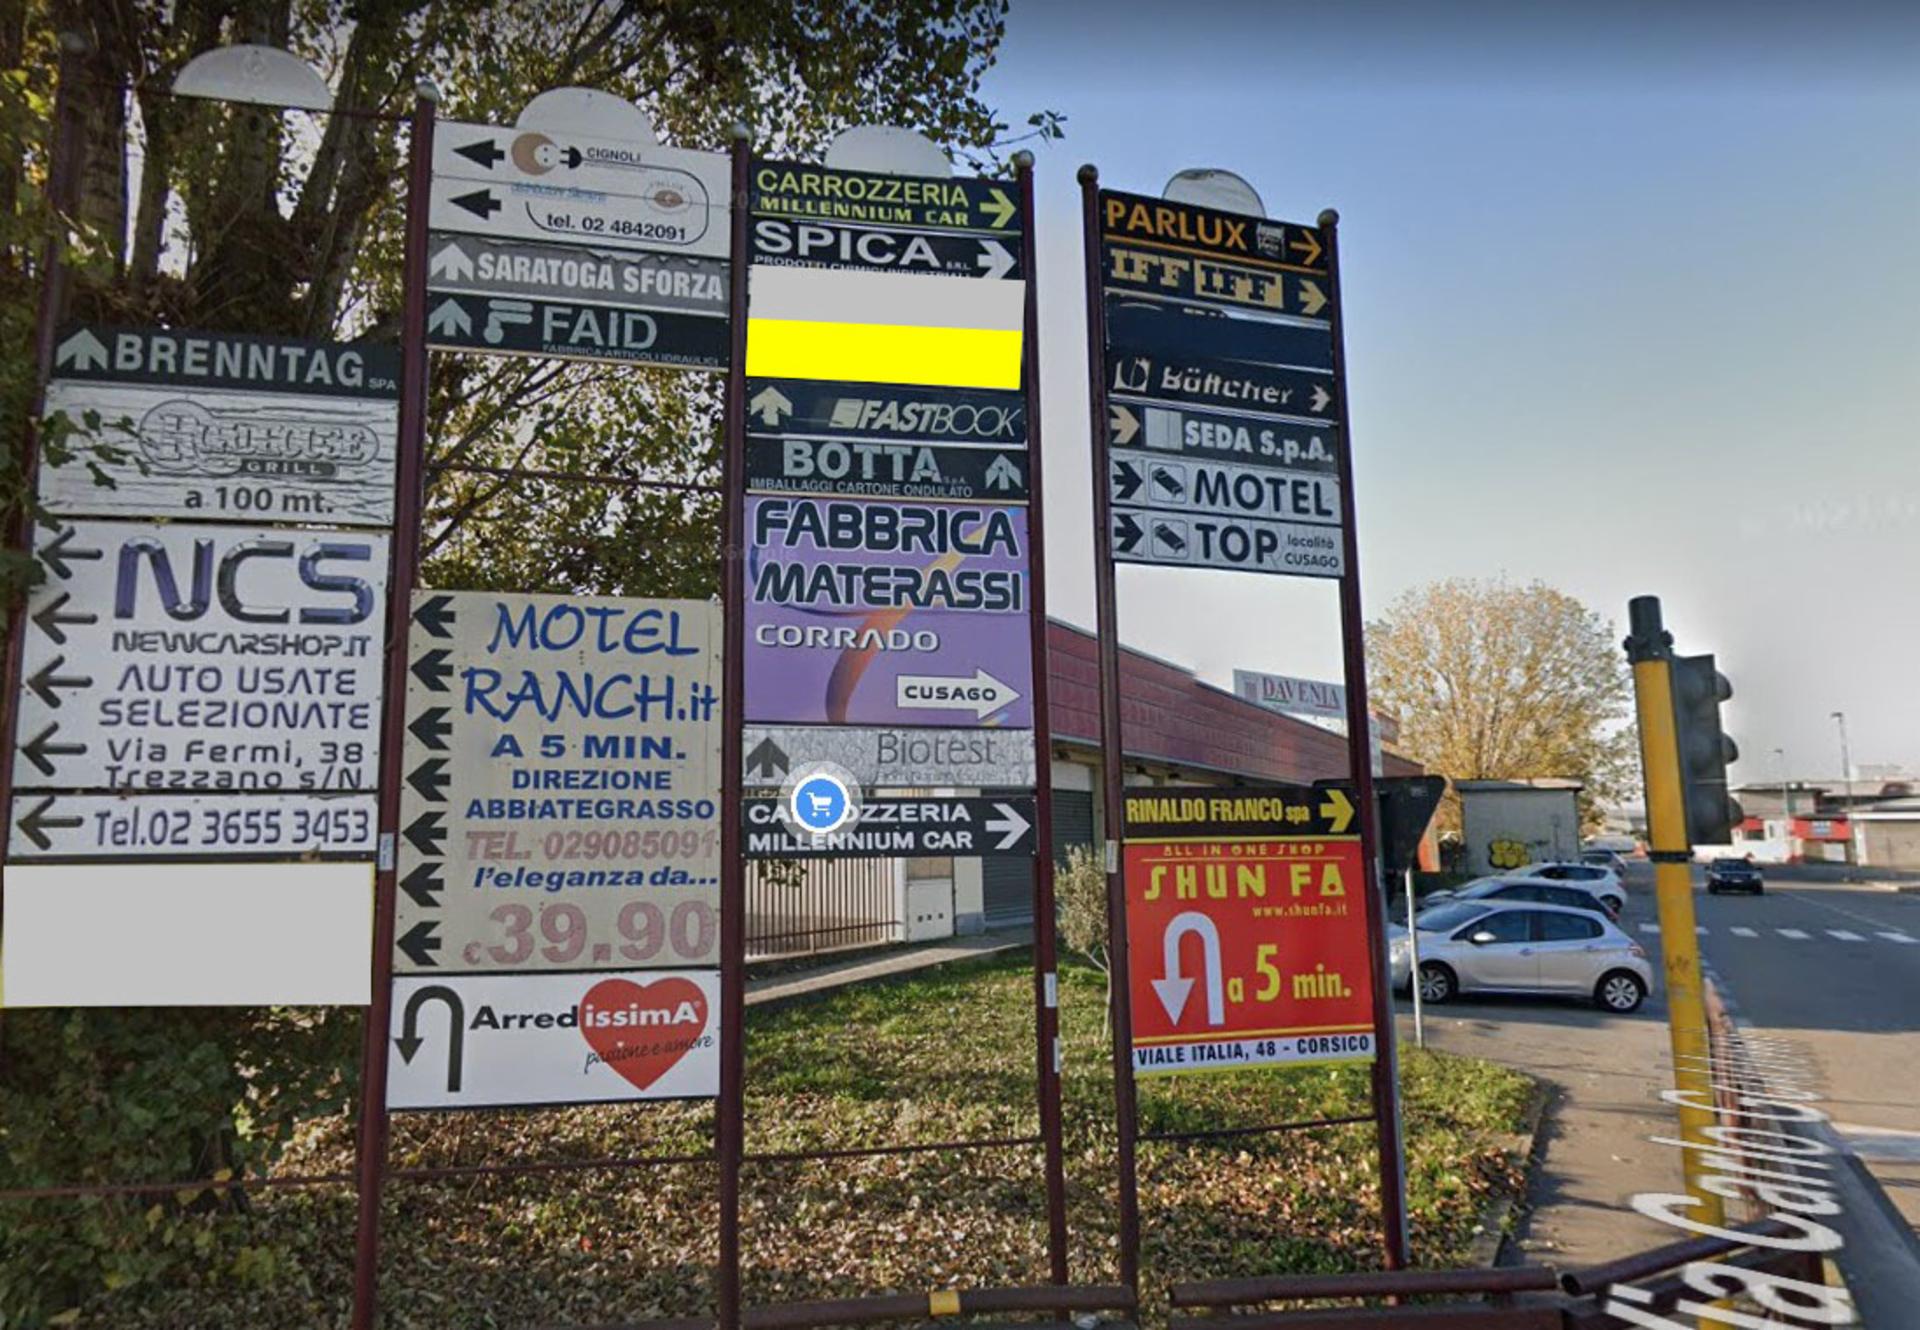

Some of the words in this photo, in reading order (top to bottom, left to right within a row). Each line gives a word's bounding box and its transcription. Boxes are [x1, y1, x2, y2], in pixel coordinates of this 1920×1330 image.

[586, 147, 642, 162] CIGNOLI
[757, 169, 970, 207] CARROZZERIA
[548, 213, 576, 230] tel.
[582, 216, 605, 233] 02
[610, 218, 687, 241] 4842091
[760, 196, 913, 223] MILLENNIUM
[925, 209, 970, 226] CAR
[1106, 199, 1249, 251] PARLUX
[755, 220, 942, 269] SPICA
[478, 252, 615, 291] SARATOGA
[623, 266, 724, 301] SFORZA
[1109, 247, 1190, 288] IFF
[1199, 262, 1279, 304] IFF
[542, 305, 658, 350] FAID
[116, 333, 365, 388] BRENNTAG
[368, 376, 398, 391] SPA
[857, 400, 1022, 437] FASTBOOK
[1185, 420, 1254, 454] SEDA
[1261, 430, 1334, 464] S.p.A.
[248, 461, 322, 475] GRILL
[783, 440, 942, 483] BOTTA
[185, 491, 203, 509] a
[215, 487, 273, 511] 100
[282, 491, 334, 514] mt.
[751, 477, 832, 492] IMBALLAGGI
[836, 481, 900, 496] CARTONE
[903, 484, 972, 498] ONDULATO
[1194, 468, 1334, 518] MOTEL
[754, 499, 1021, 558] FABBRICA
[1195, 523, 1279, 565] TOP
[1284, 552, 1339, 568] CUSAGO
[114, 536, 375, 626] NCS
[753, 561, 1024, 613] MATERASSI
[112, 631, 371, 657] NEWCARSHOP.IT
[487, 601, 700, 656] MOTEL
[756, 624, 941, 653] CORRADO
[118, 664, 223, 694] AUTO
[238, 668, 357, 696] USATE
[460, 666, 718, 722] RANCH.it
[904, 685, 998, 701] CUSAGO
[100, 700, 371, 729] SELEZIONATE
[107, 738, 167, 763] Via
[184, 738, 302, 768] Fermi,
[320, 741, 364, 764] 38
[490, 734, 525, 758] A
[540, 734, 567, 758] 5
[583, 735, 687, 759] MIN.
[878, 732, 997, 765] Biotest
[105, 765, 283, 790] Trezzano
[299, 765, 363, 790] s/N
[512, 769, 673, 791] DIREZIONE
[465, 799, 716, 820] ABBIATEGRASSO
[748, 803, 972, 824] CAOZZERIA
[1126, 799, 1205, 823] RINALDO
[1210, 798, 1283, 822] FRANCO
[1285, 804, 1310, 822] spa
[95, 806, 191, 846] Tel.02
[201, 810, 282, 845] 3655
[292, 809, 370, 844] 3453
[748, 832, 915, 852] MILLENNIUM
[922, 831, 973, 850] CAR
[465, 830, 532, 861] TEL.
[543, 829, 717, 861] 029085091
[1163, 845, 1193, 857] ALL
[1203, 845, 1222, 857] IN
[1231, 844, 1268, 856] ONE
[1276, 843, 1325, 856] SHOP
[650, 866, 718, 887] da...
[1144, 863, 1267, 901] SHUN
[1290, 863, 1346, 897] FA
[1253, 902, 1348, 918] www.shunfa.it
[1227, 977, 1246, 1003] a
[1256, 944, 1281, 1003] 5
[1292, 963, 1353, 1000] min.
[1138, 1047, 1185, 1066] VIALE
[1191, 1042, 1250, 1062] ITALIA,
[1256, 1041, 1277, 1057] 48
[1297, 1034, 1370, 1055] CORSICO
